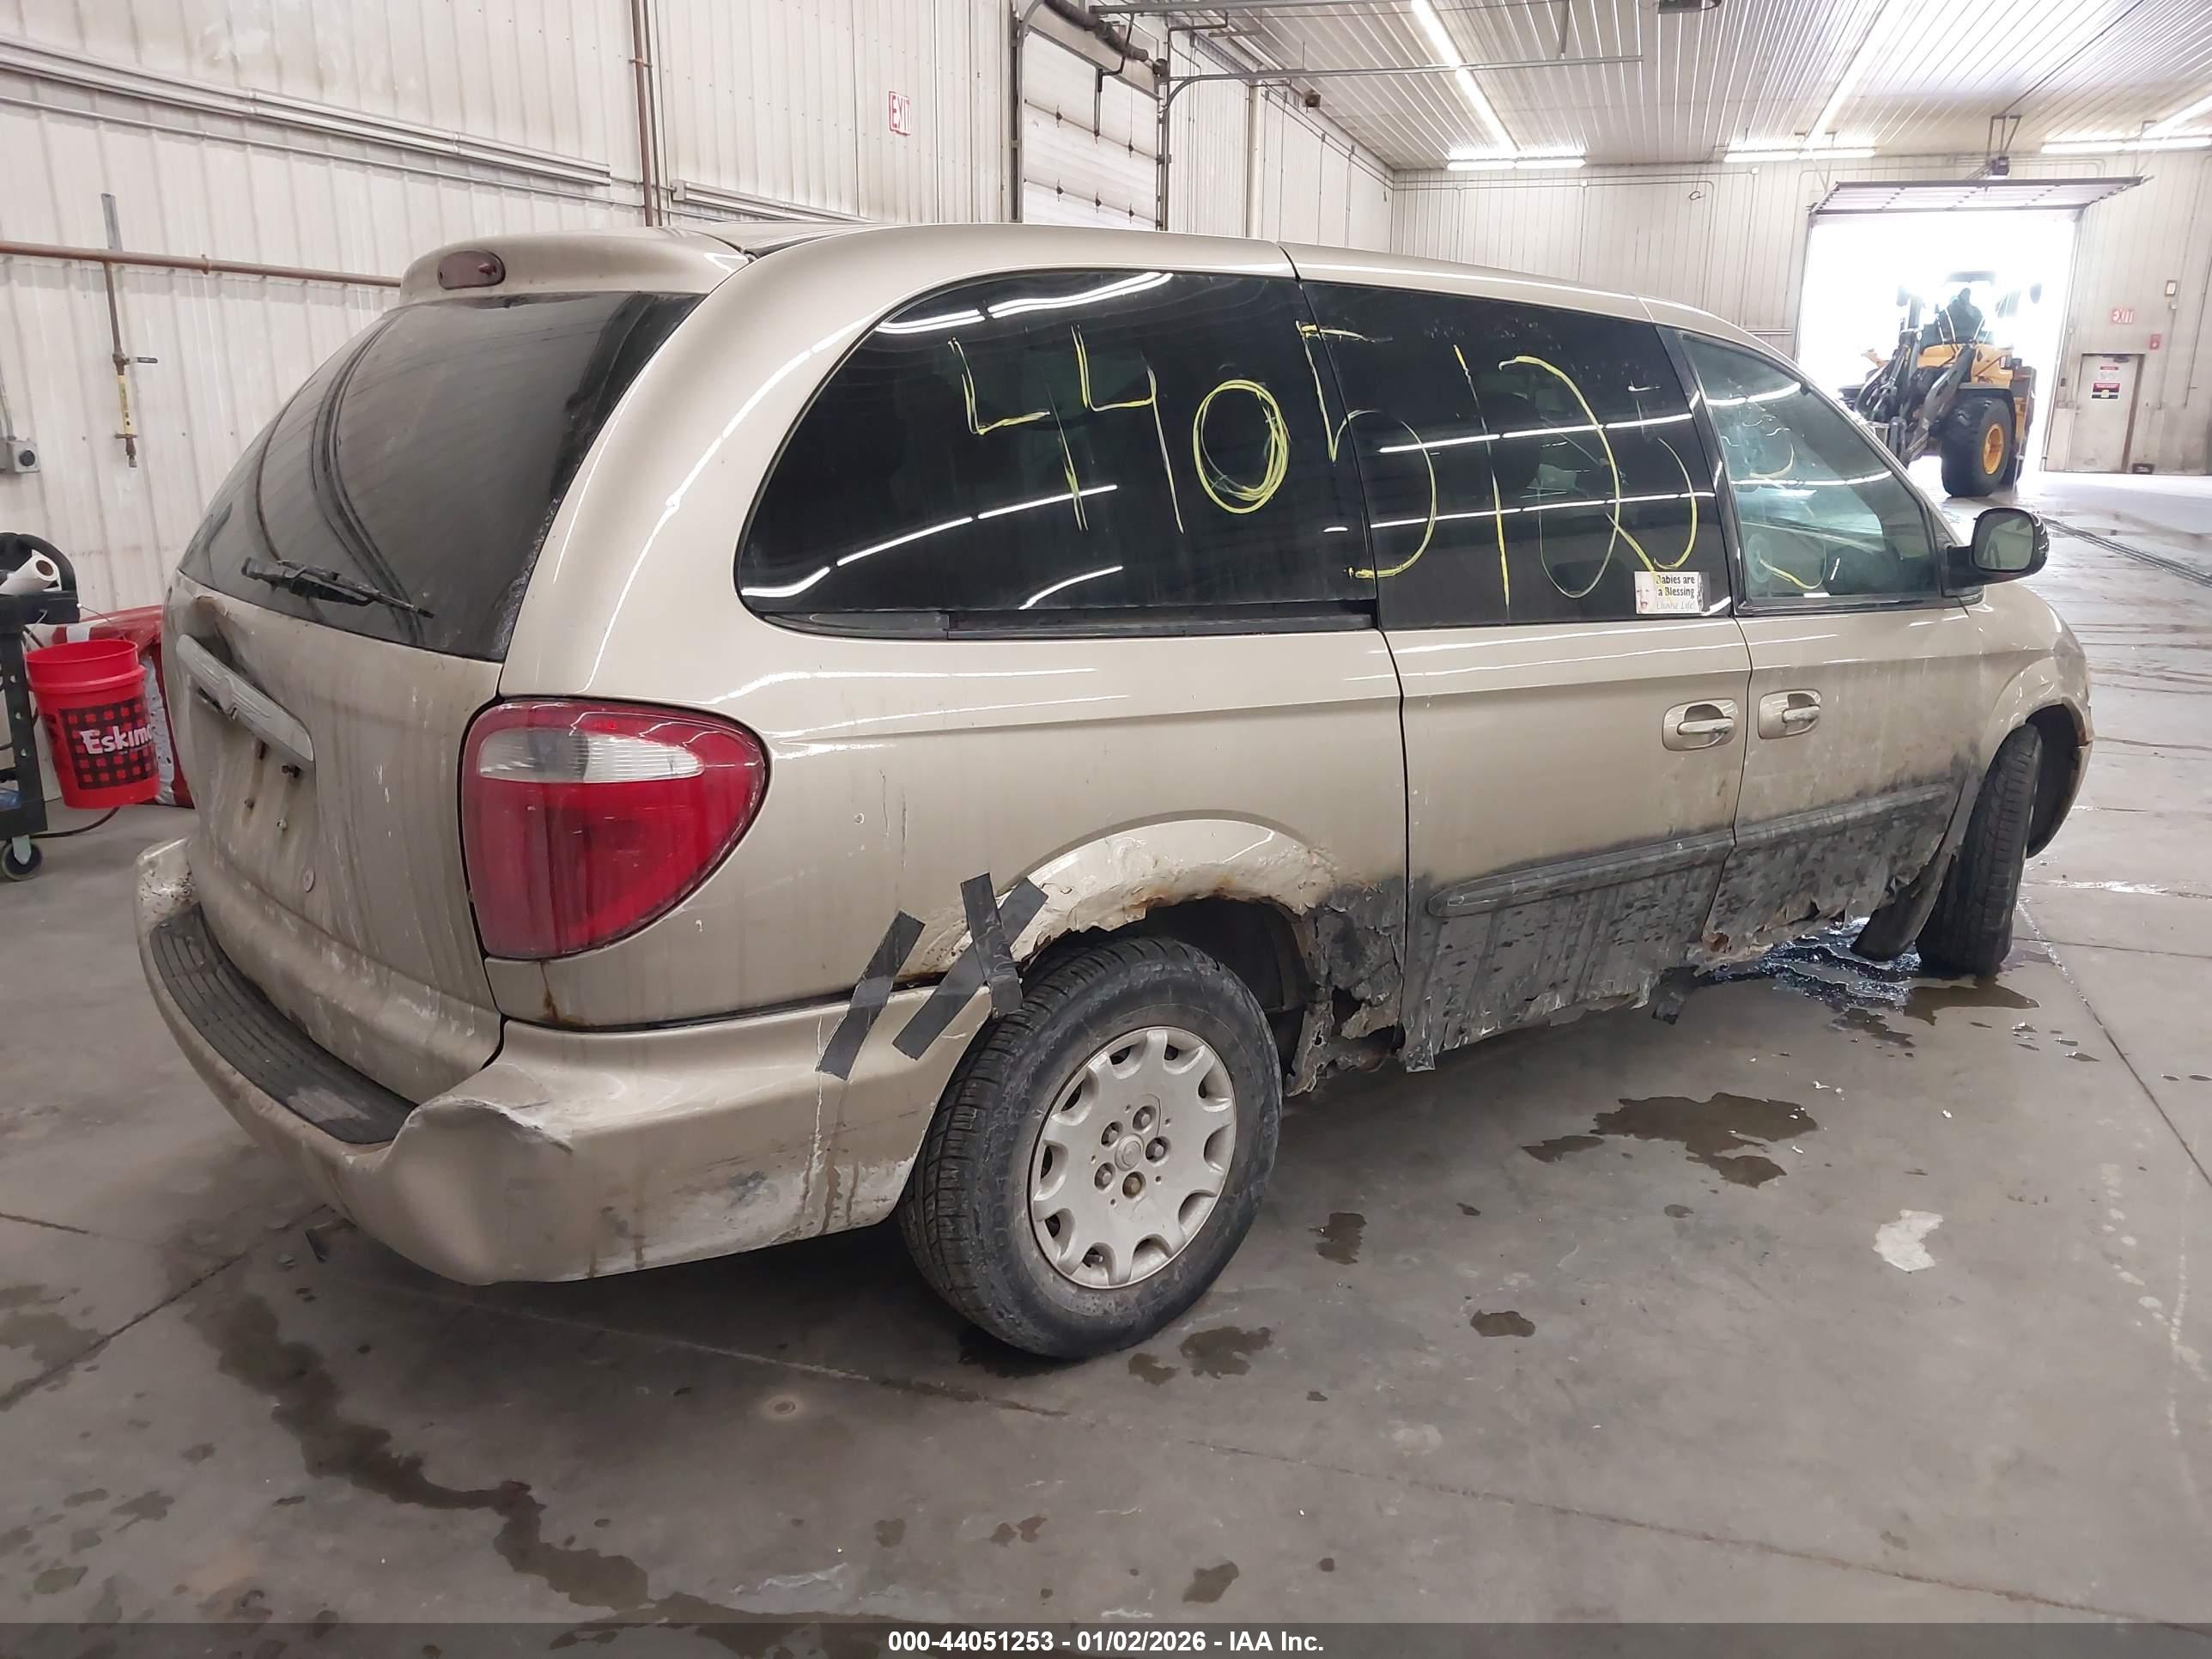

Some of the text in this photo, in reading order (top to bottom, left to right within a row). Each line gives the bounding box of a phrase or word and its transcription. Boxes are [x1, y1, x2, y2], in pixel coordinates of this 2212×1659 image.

[891, 94, 910, 132] EXIT
[1683, 576, 1695, 585] are
[1665, 586, 1695, 599] Blessing
